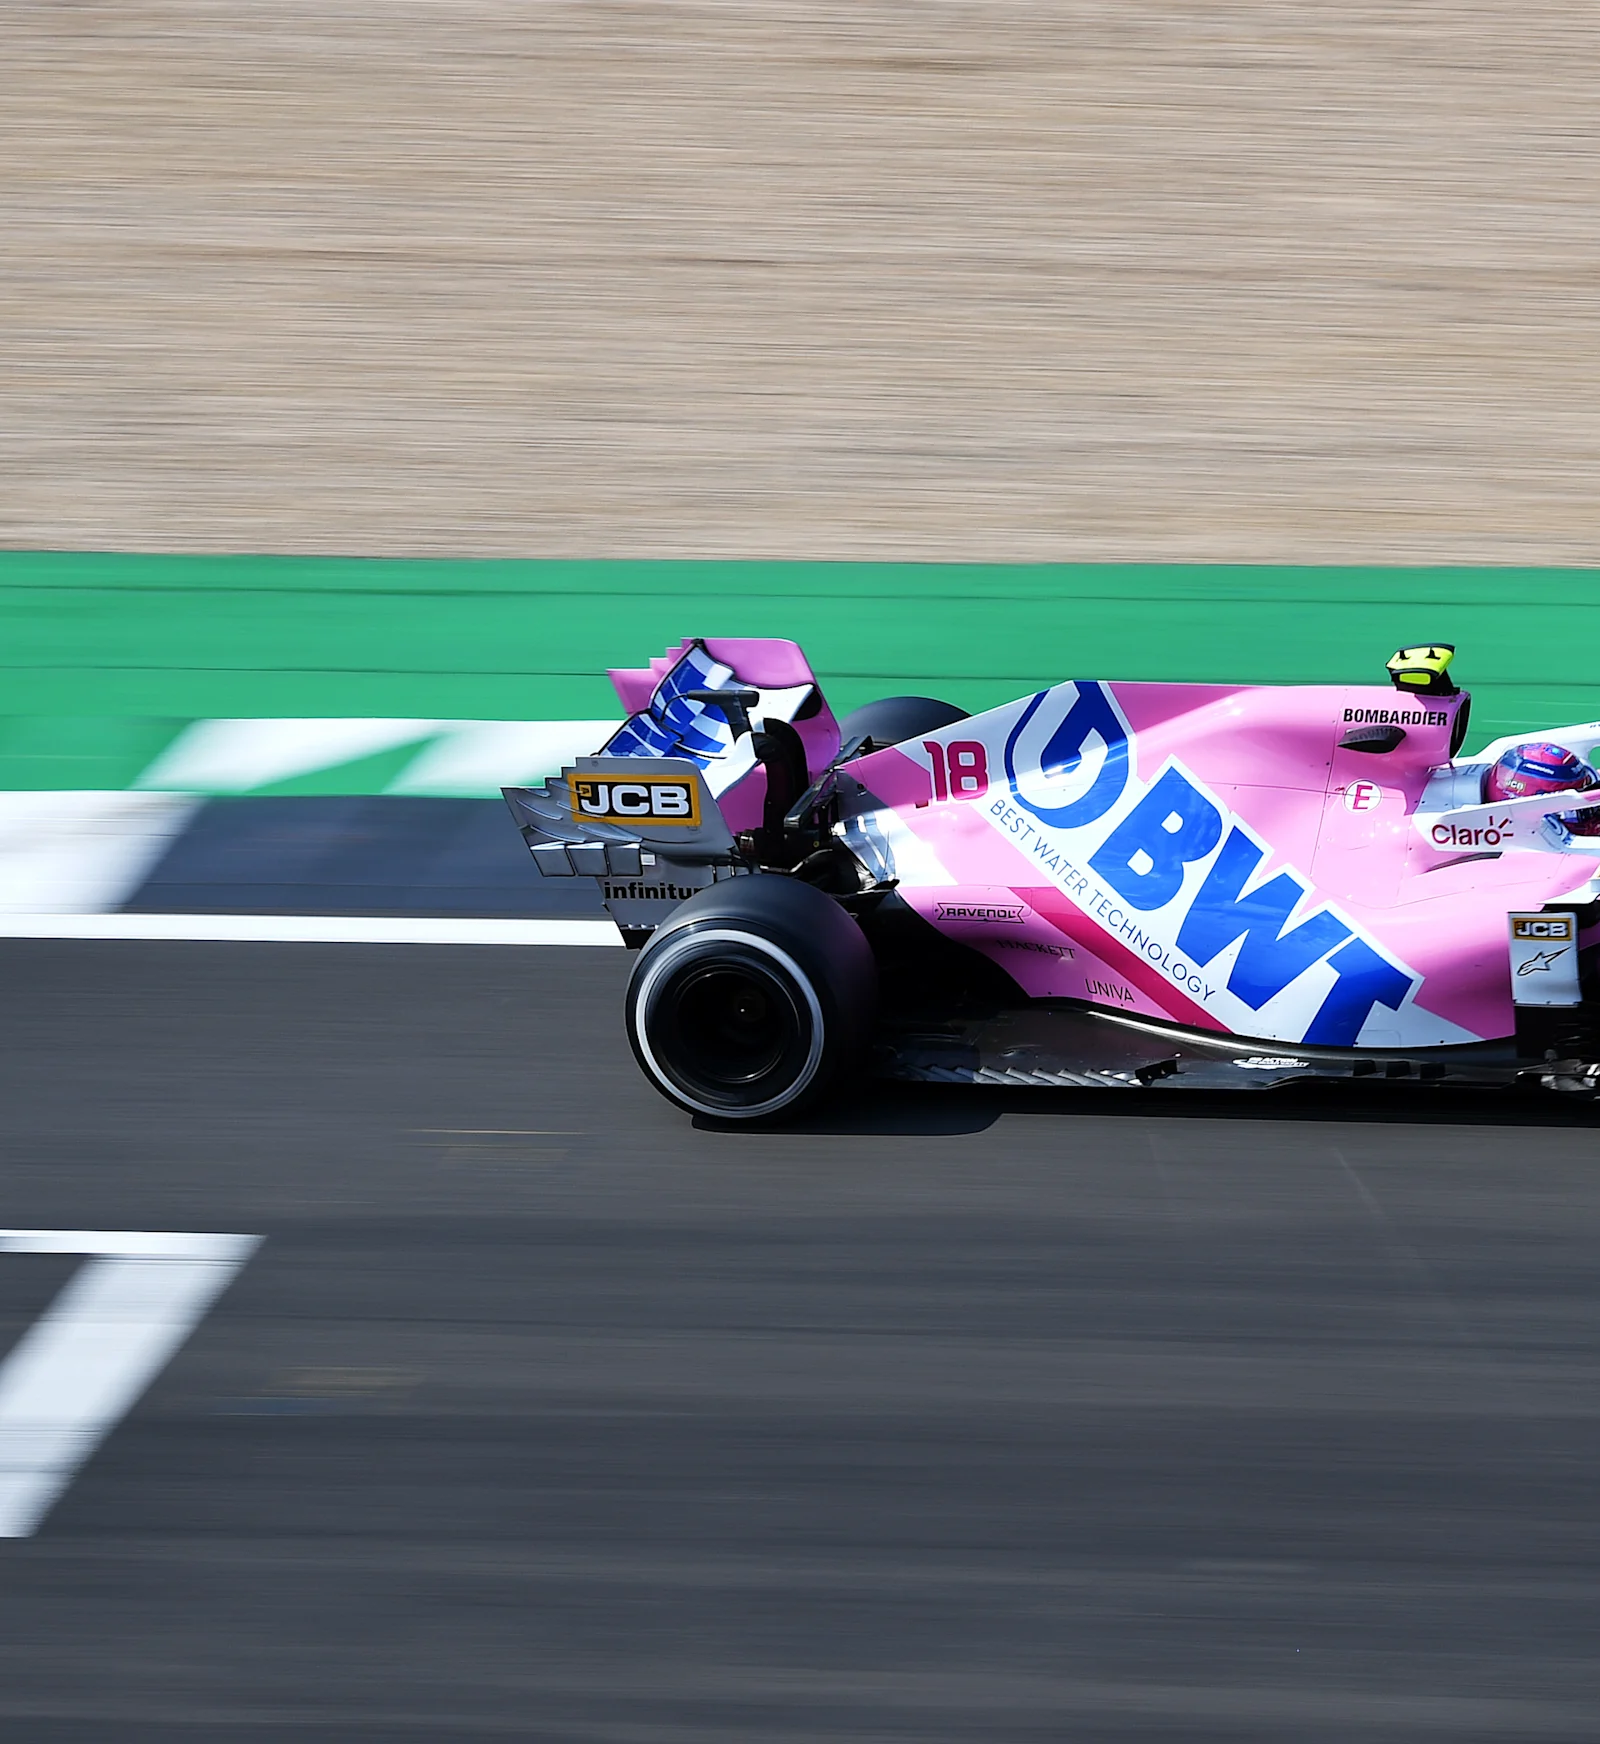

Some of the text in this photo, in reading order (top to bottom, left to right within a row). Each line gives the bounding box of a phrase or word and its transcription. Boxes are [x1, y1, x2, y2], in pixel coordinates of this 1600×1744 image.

[1343, 708, 1449, 726] BOMBARDIER
[922, 740, 989, 802] 18
[580, 784, 690, 815] JCB
[1352, 784, 1373, 810] E
[1432, 823, 1501, 846] Claro
[946, 906, 1016, 920] RAVENOL
[989, 799, 1217, 1002] BEST WATER TECHNOLOGY
[1088, 766, 1414, 1047] BWT
[1516, 922, 1569, 937] JCB
[1085, 978, 1136, 1004] UNIVA
